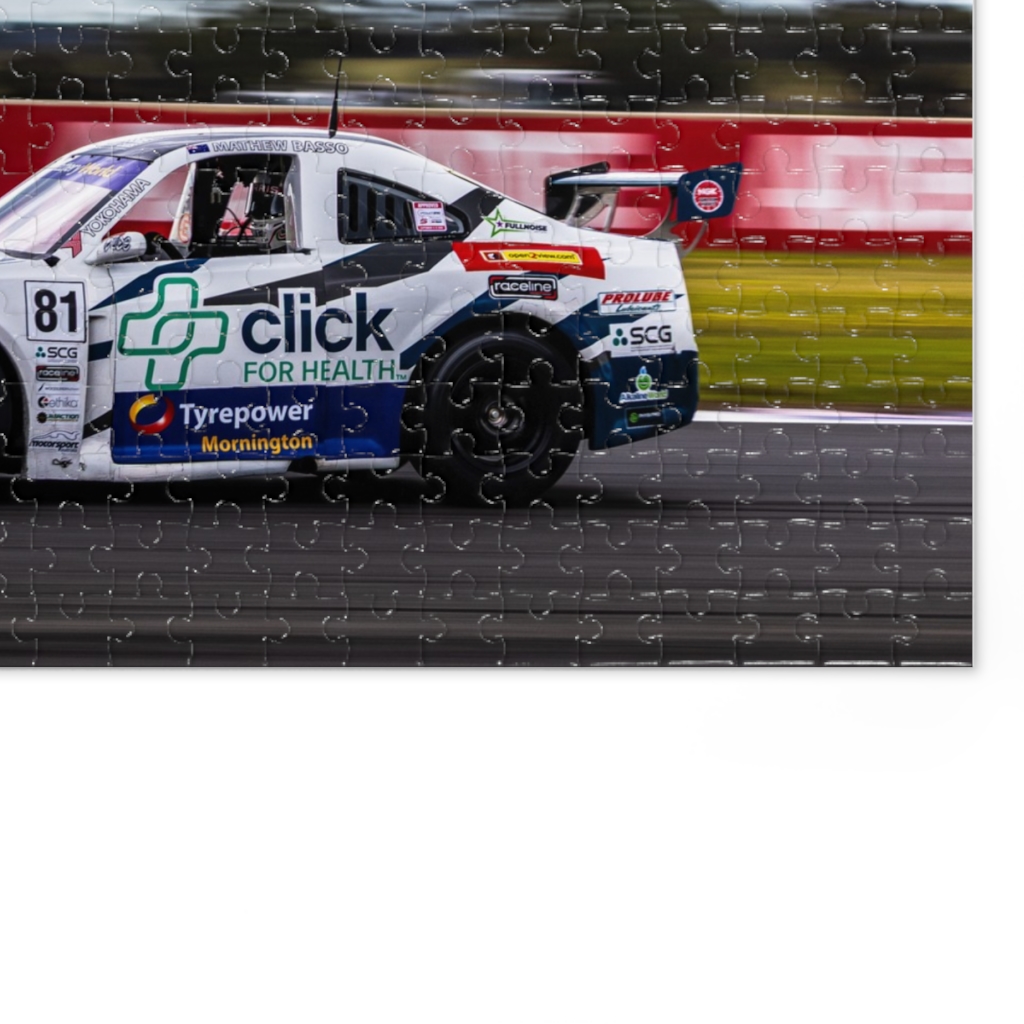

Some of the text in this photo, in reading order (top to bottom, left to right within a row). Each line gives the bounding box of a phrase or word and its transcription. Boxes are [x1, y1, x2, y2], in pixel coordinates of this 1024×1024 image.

[212, 139, 349, 155] MATHEW BASSO
[79, 178, 151, 237] YOKOHAMA
[505, 223, 547, 232] FULLNOISE
[495, 281, 552, 292] raceline
[601, 291, 673, 305] PROLUBE
[34, 290, 77, 334] 81
[241, 292, 395, 354] click
[630, 325, 672, 345] SCG
[47, 347, 78, 359] SCG
[244, 361, 294, 383] FOR
[302, 359, 395, 382] HEALTH
[179, 403, 314, 430] Tyrepower
[29, 440, 79, 451] motorsport
[201, 434, 314, 455] Mornington
